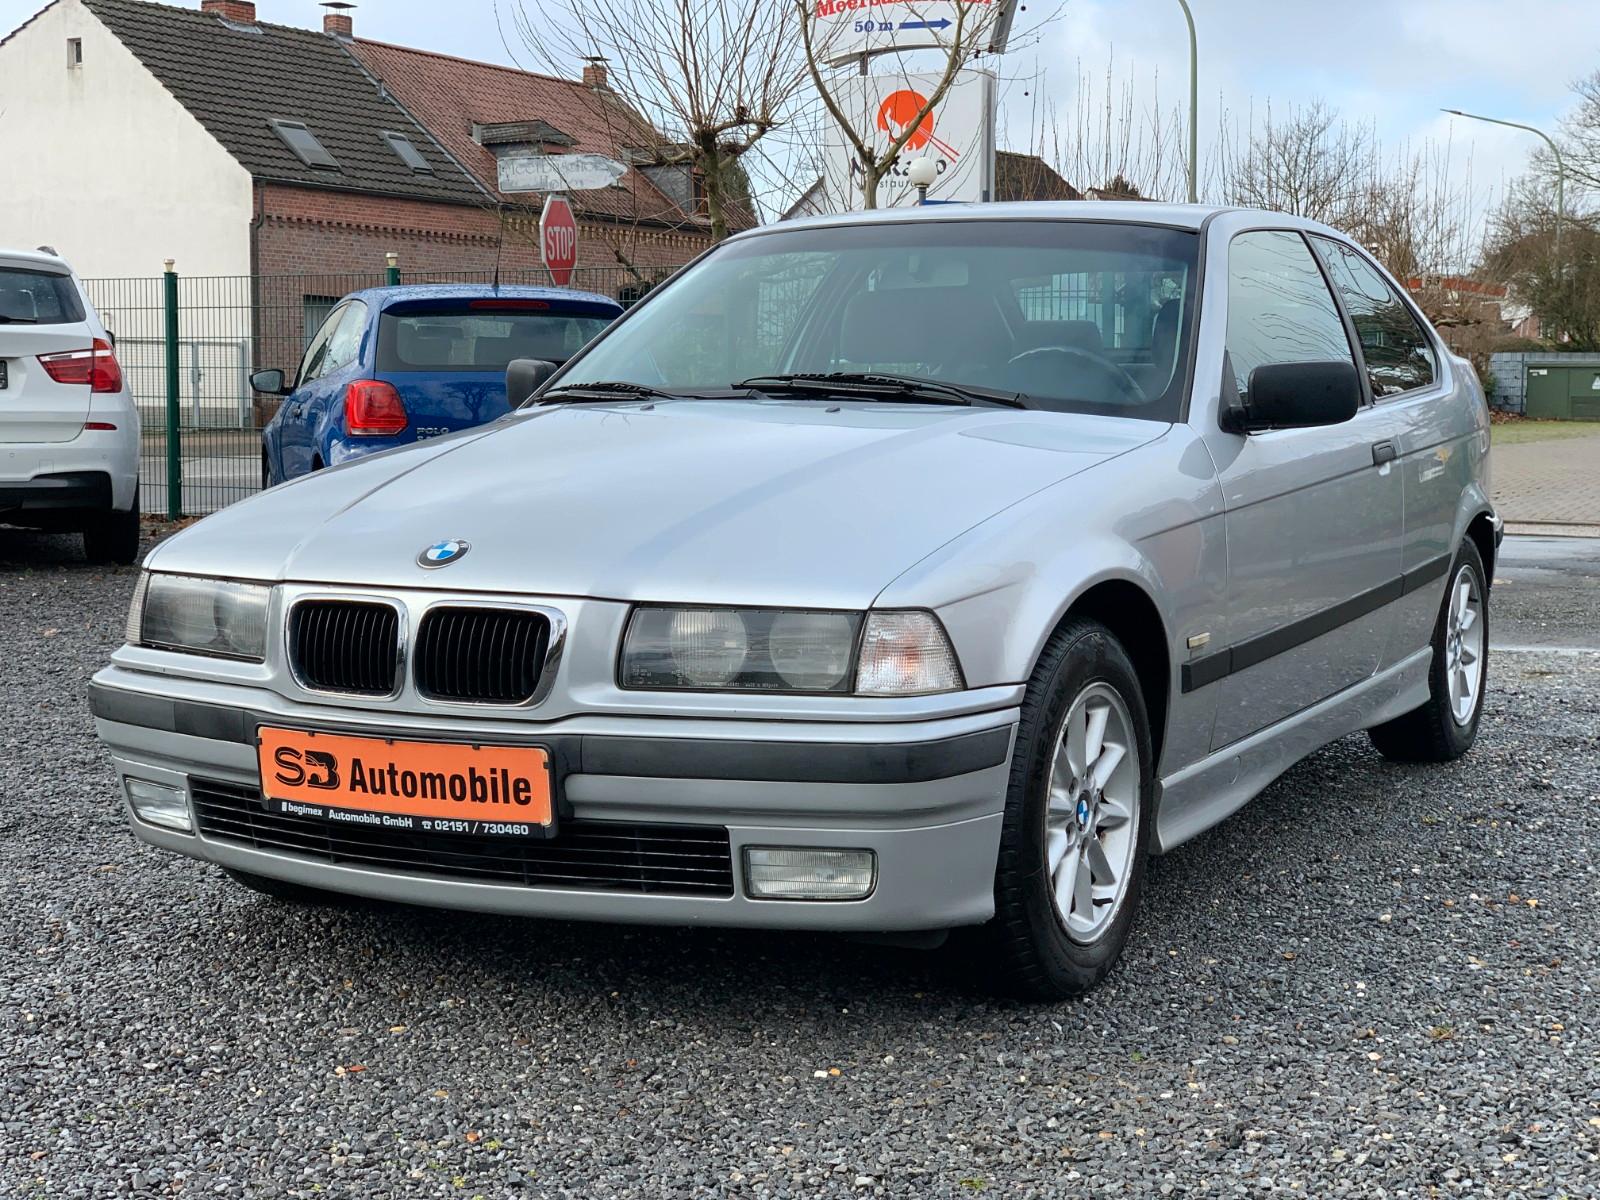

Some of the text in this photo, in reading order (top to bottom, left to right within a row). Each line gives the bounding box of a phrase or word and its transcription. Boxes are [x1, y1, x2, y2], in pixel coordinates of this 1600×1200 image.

[854, 20, 893, 32] 50 m
[546, 226, 574, 261] STOP
[416, 427, 449, 435] POLO
[349, 758, 532, 806] Automobile
[288, 802, 323, 816] begimex
[329, 809, 381, 825] Automobile
[382, 815, 413, 828] GmbH
[434, 820, 469, 832] 02151
[482, 823, 529, 835] 730460
